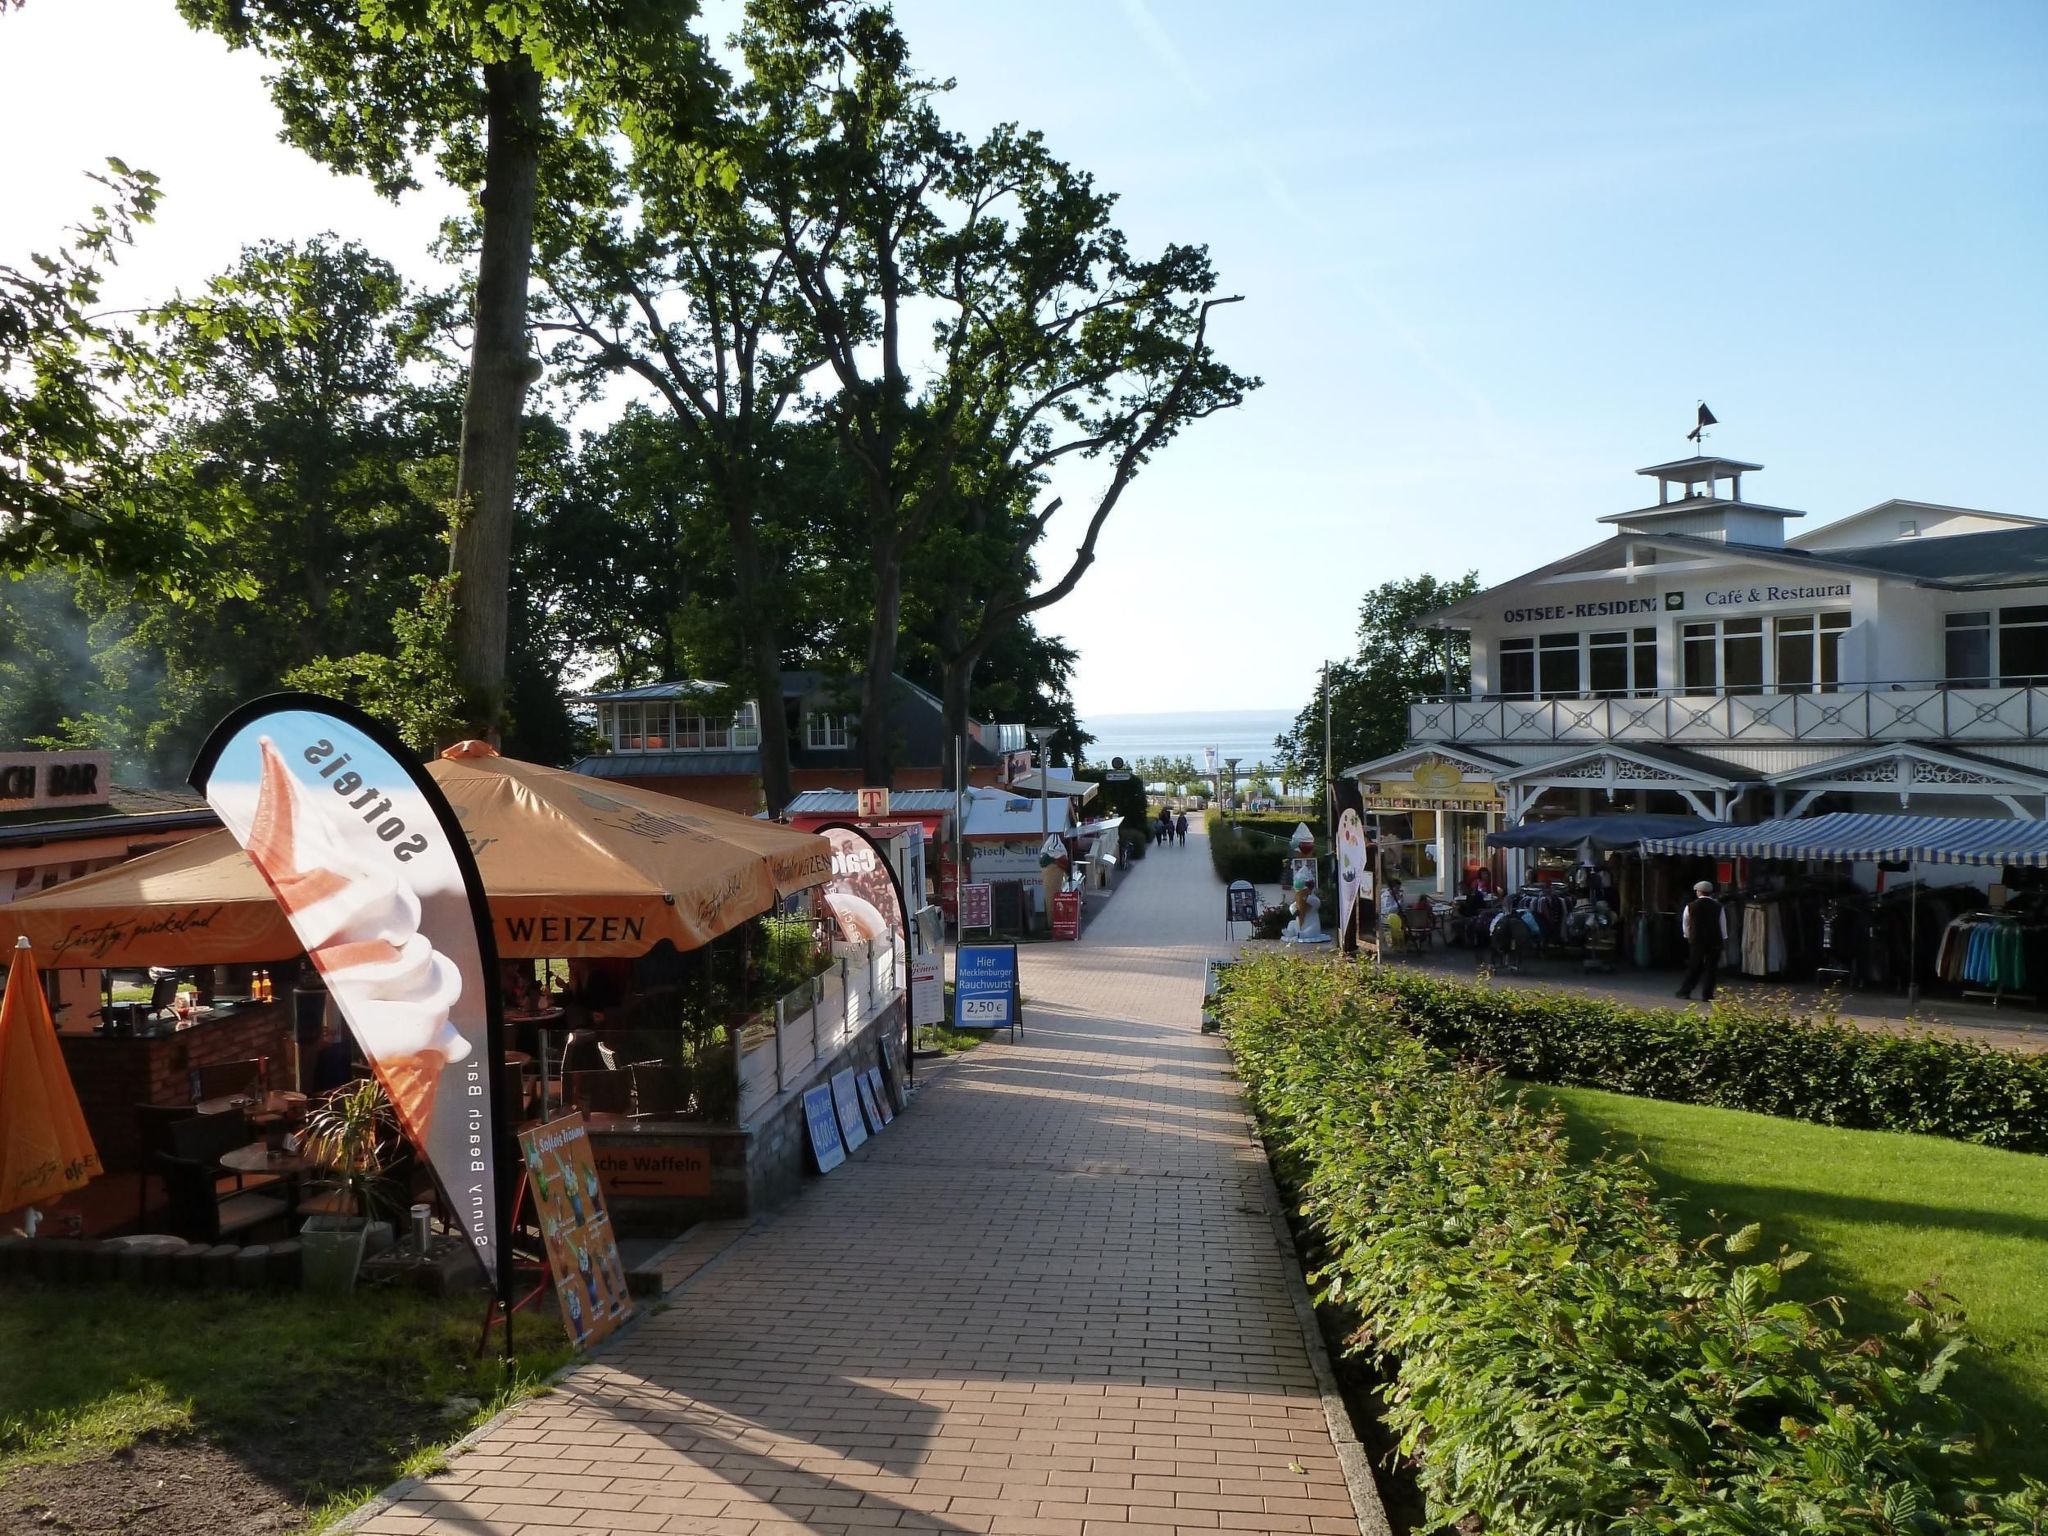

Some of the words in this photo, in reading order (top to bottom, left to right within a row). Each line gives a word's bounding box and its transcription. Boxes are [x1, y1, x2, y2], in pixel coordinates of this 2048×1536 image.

[1705, 589, 1742, 606] Café
[1747, 588, 1761, 603] &
[47, 763, 97, 796] BAR
[504, 916, 646, 942] WEIZEN
[976, 956, 997, 967] Hier
[960, 968, 1013, 978] Mecklenburger
[959, 979, 1012, 989] Rauchwurst
[966, 1001, 994, 1014] 2,50
[996, 1003, 1004, 1013] €
[633, 1155, 701, 1172] Waffeln
